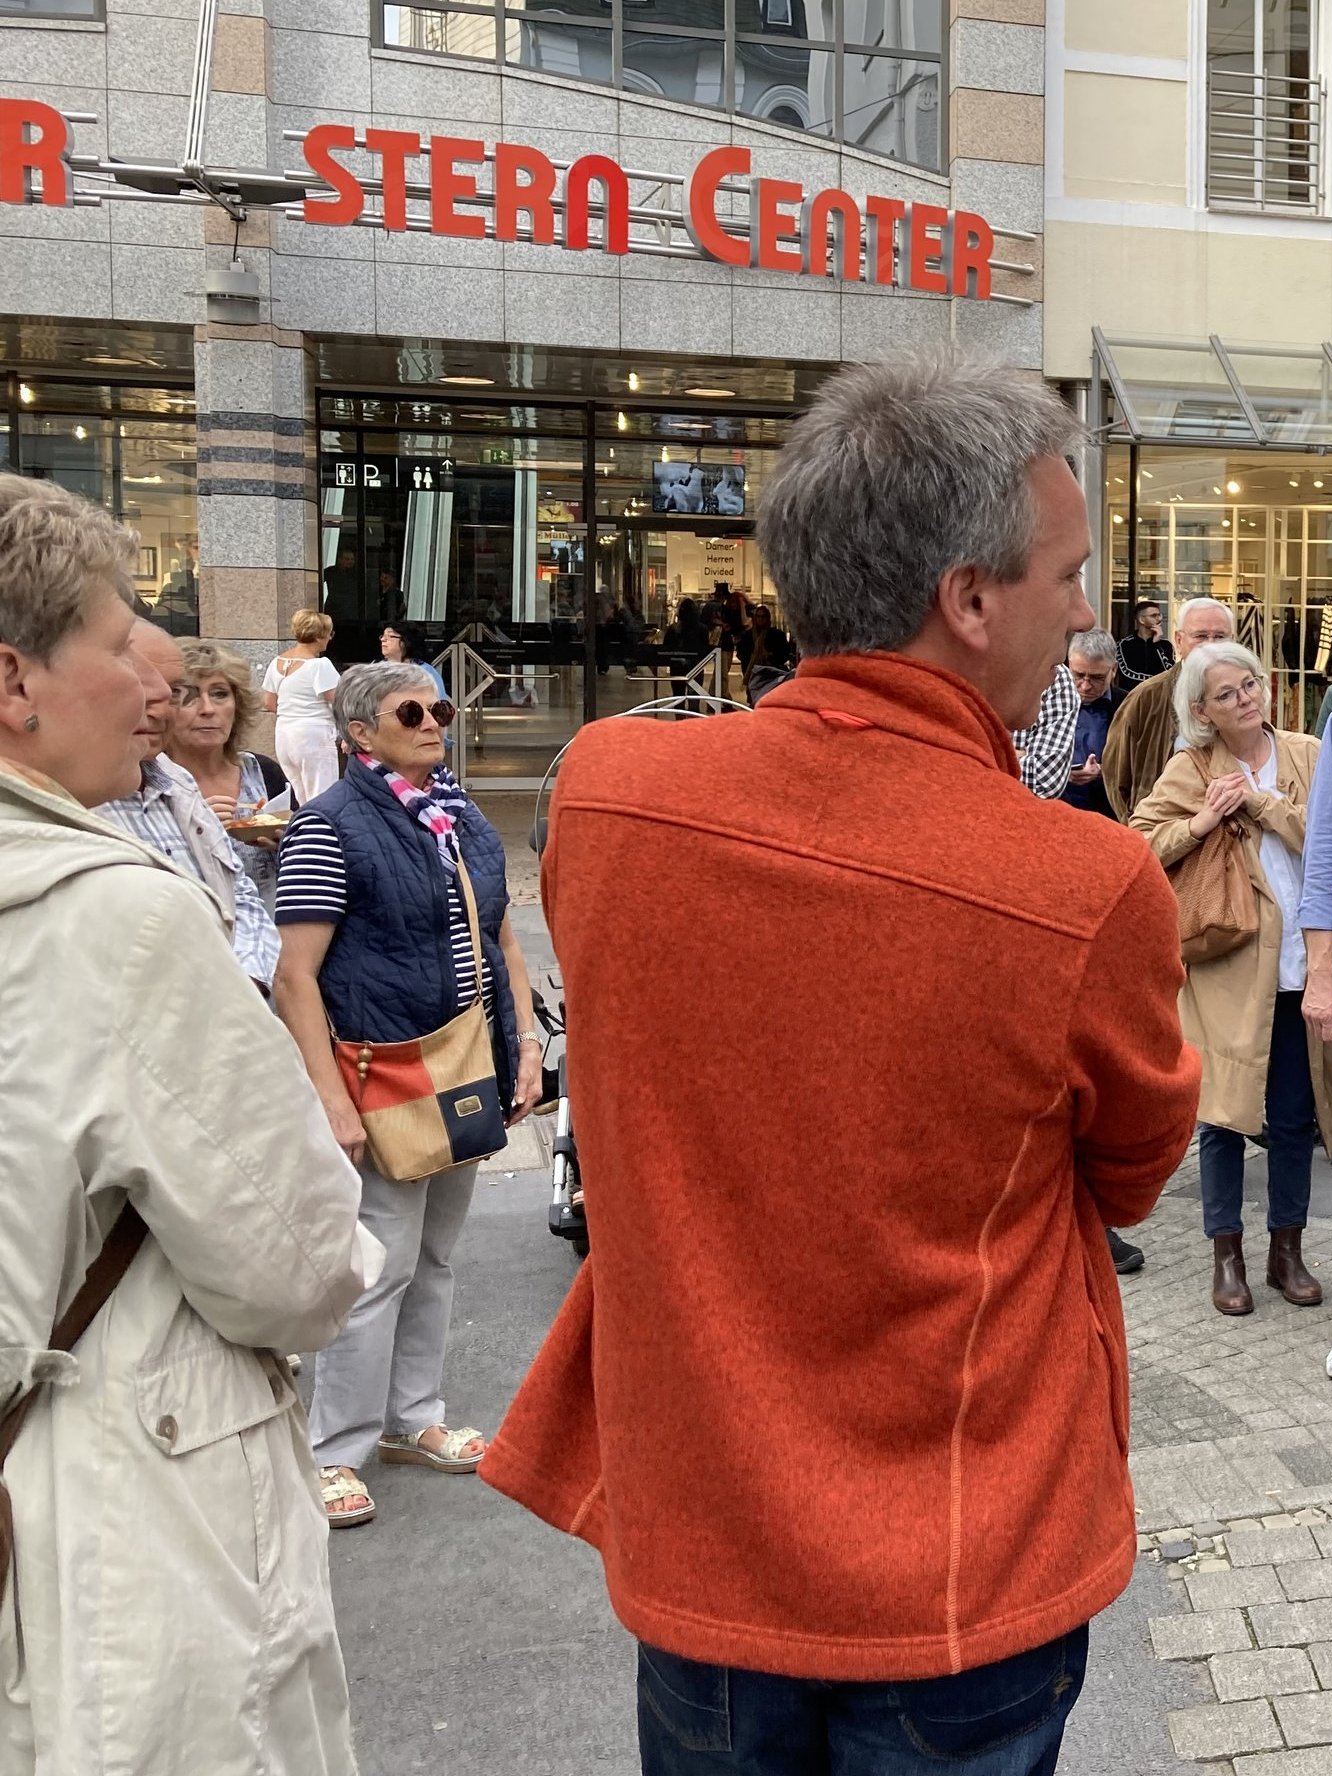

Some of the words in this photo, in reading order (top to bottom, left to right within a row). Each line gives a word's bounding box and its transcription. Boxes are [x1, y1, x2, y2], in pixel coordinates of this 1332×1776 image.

[303, 124, 629, 256] STERN
[705, 541, 735, 550] Damen
[706, 554, 734, 563] Herren
[704, 567, 734, 576] Divided
